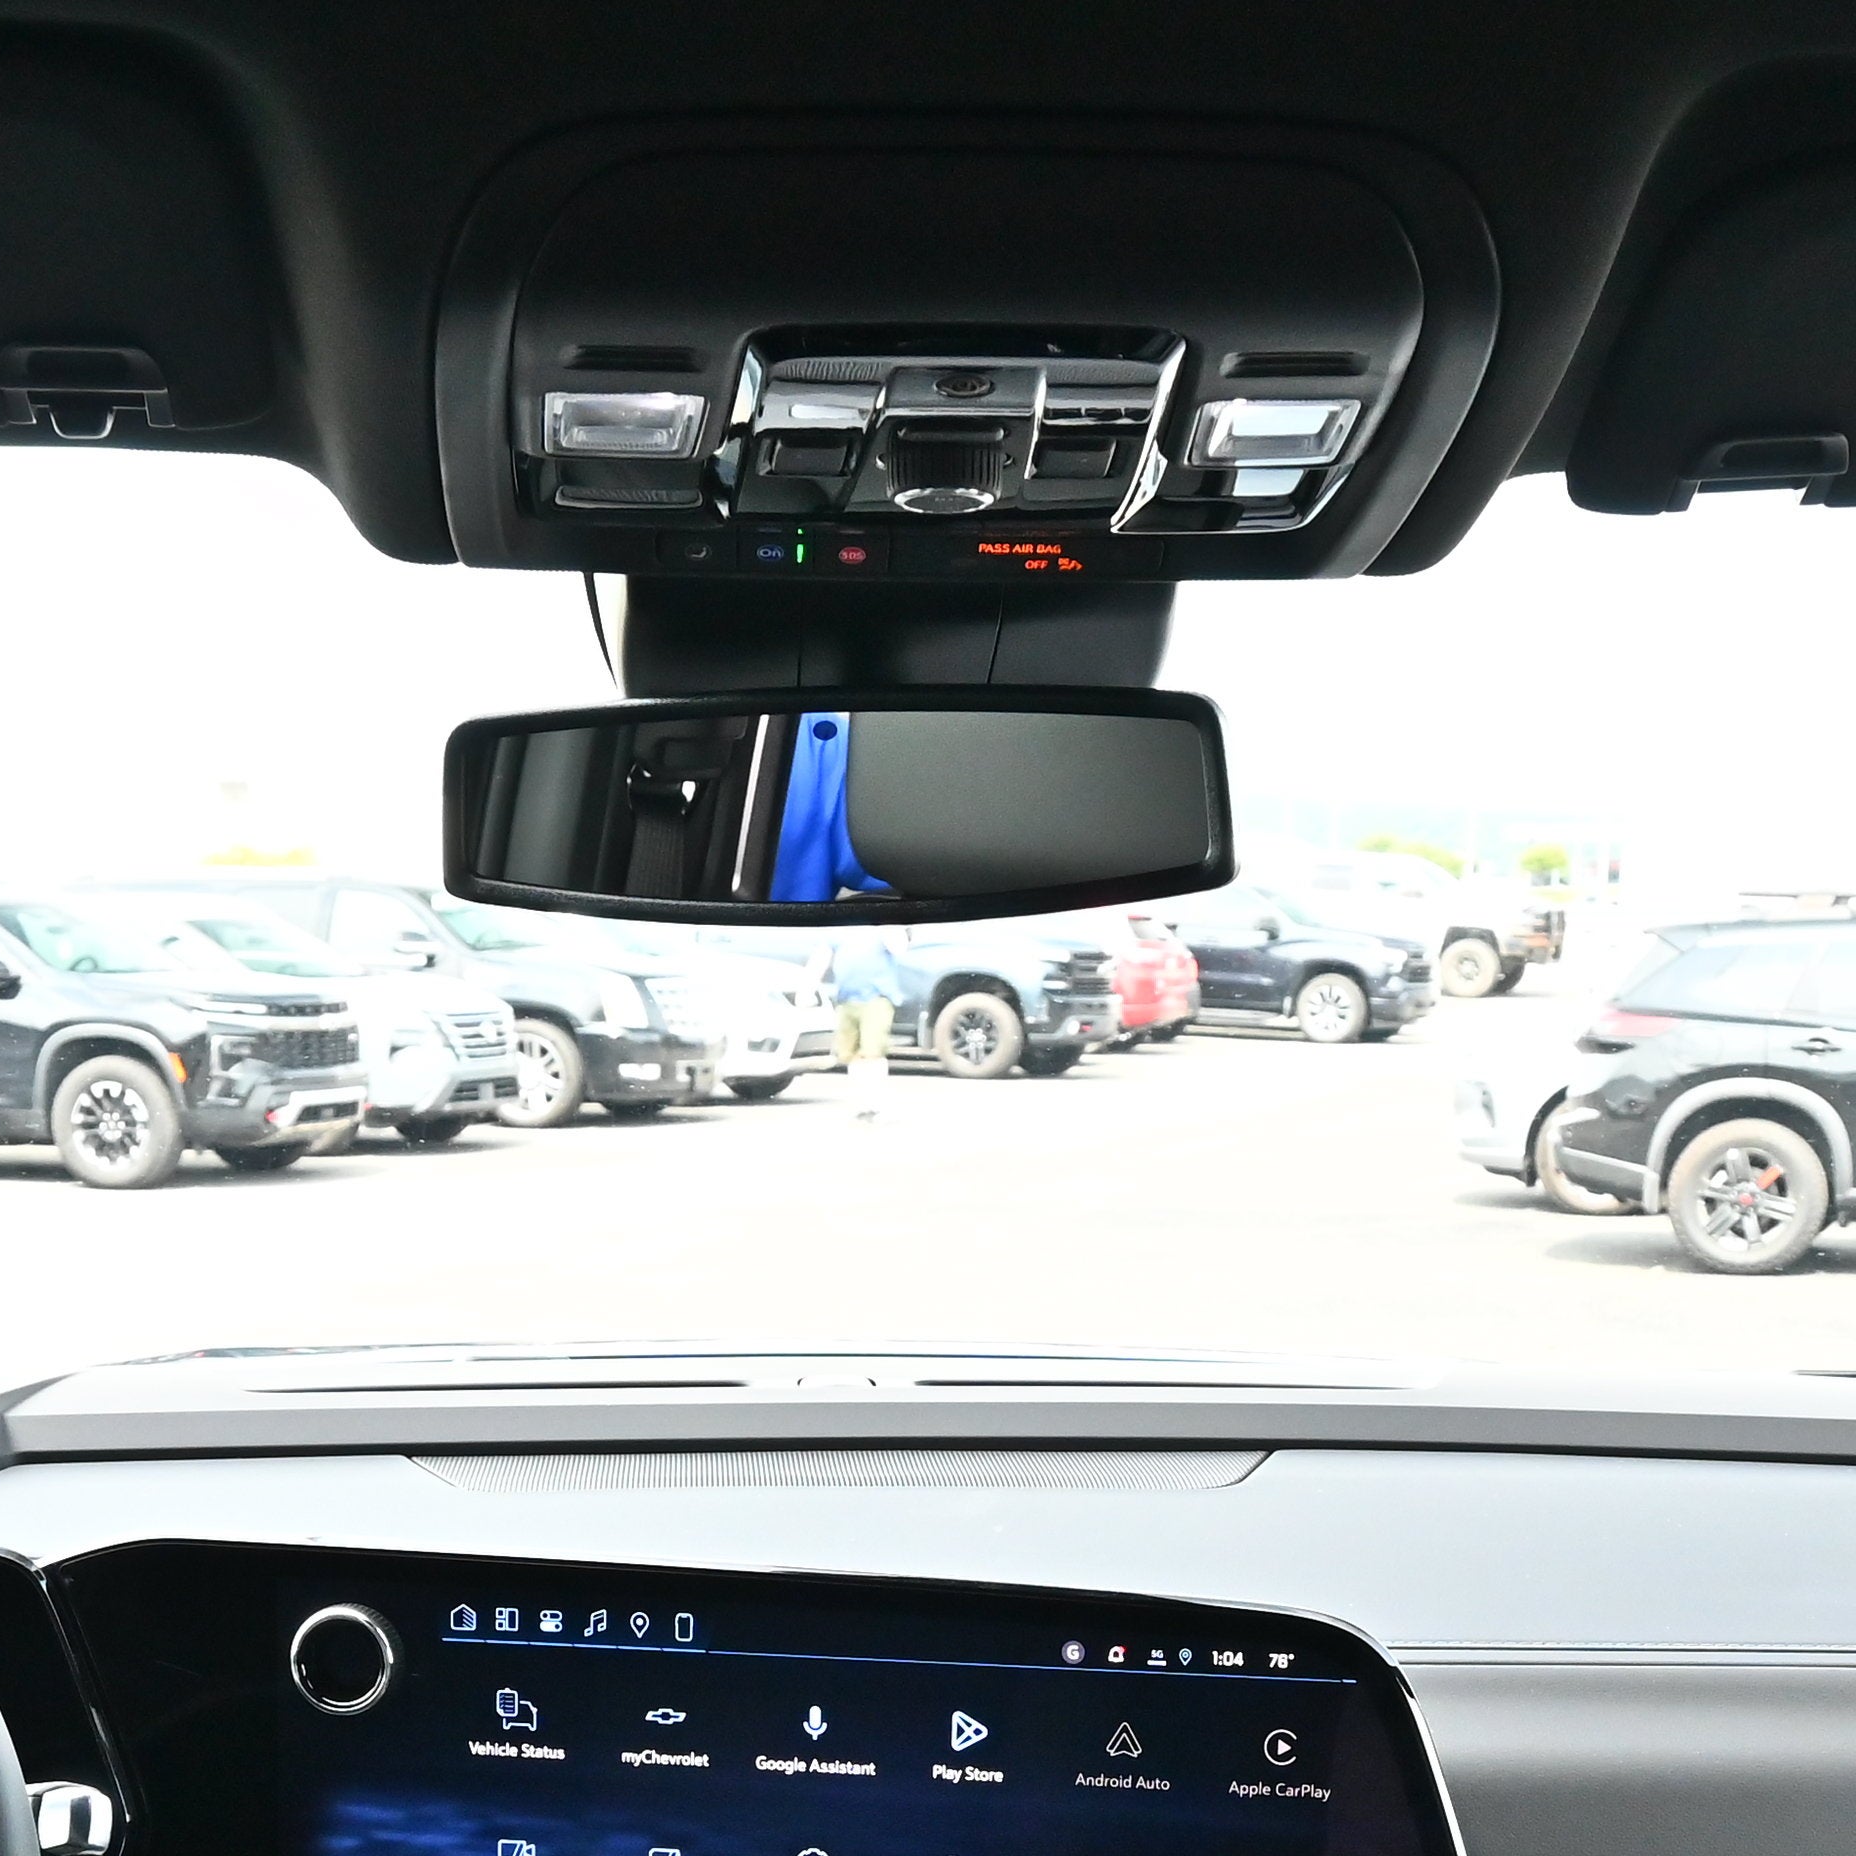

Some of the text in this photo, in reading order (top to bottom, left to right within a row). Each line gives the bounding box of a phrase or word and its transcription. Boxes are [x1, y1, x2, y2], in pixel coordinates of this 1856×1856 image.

[978, 543, 1062, 555] PASS AIR BAG
[1024, 560, 1048, 570] OFF
[1150, 1649, 1164, 1659] 5G
[1212, 1650, 1244, 1667] 1:04
[469, 1741, 566, 1761] Vehicle Status
[621, 1748, 710, 1769] myChevrolet
[755, 1755, 876, 1778] Google Assistant
[932, 1764, 1004, 1784] Play Store
[1075, 1773, 1171, 1793] Android Auto
[1228, 1780, 1331, 1802] Apple CarPlay
